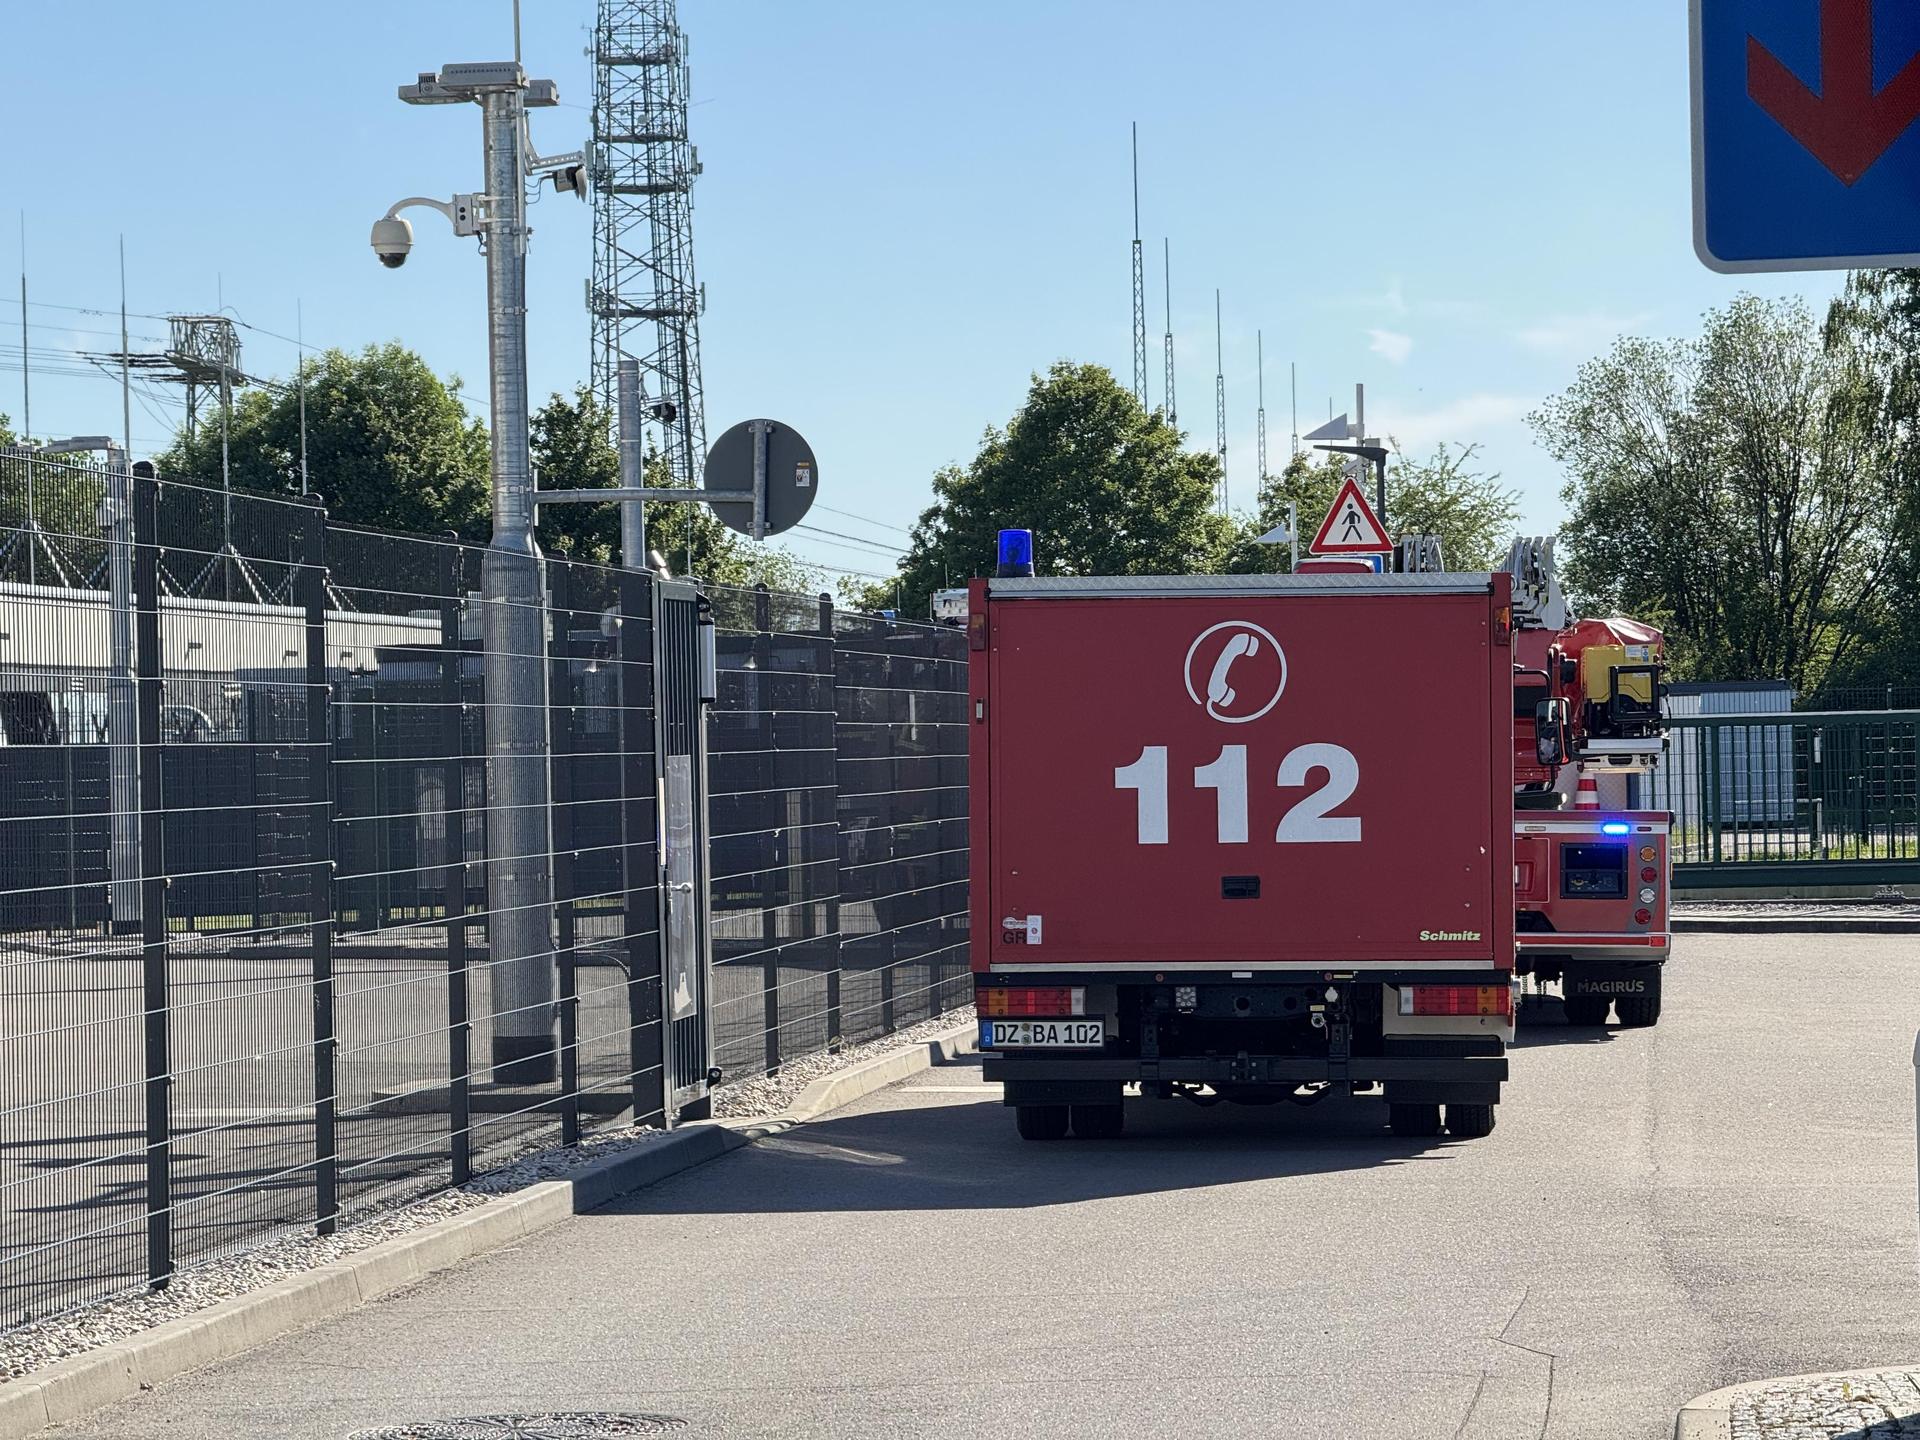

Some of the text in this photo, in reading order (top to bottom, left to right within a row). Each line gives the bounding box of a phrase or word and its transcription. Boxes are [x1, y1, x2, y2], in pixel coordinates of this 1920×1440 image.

[1114, 742, 1362, 844] 112
[1419, 930, 1481, 941] Schmitz
[1577, 979, 1645, 993] MAGIRUS
[994, 1024, 1101, 1043] DZ BA 102
